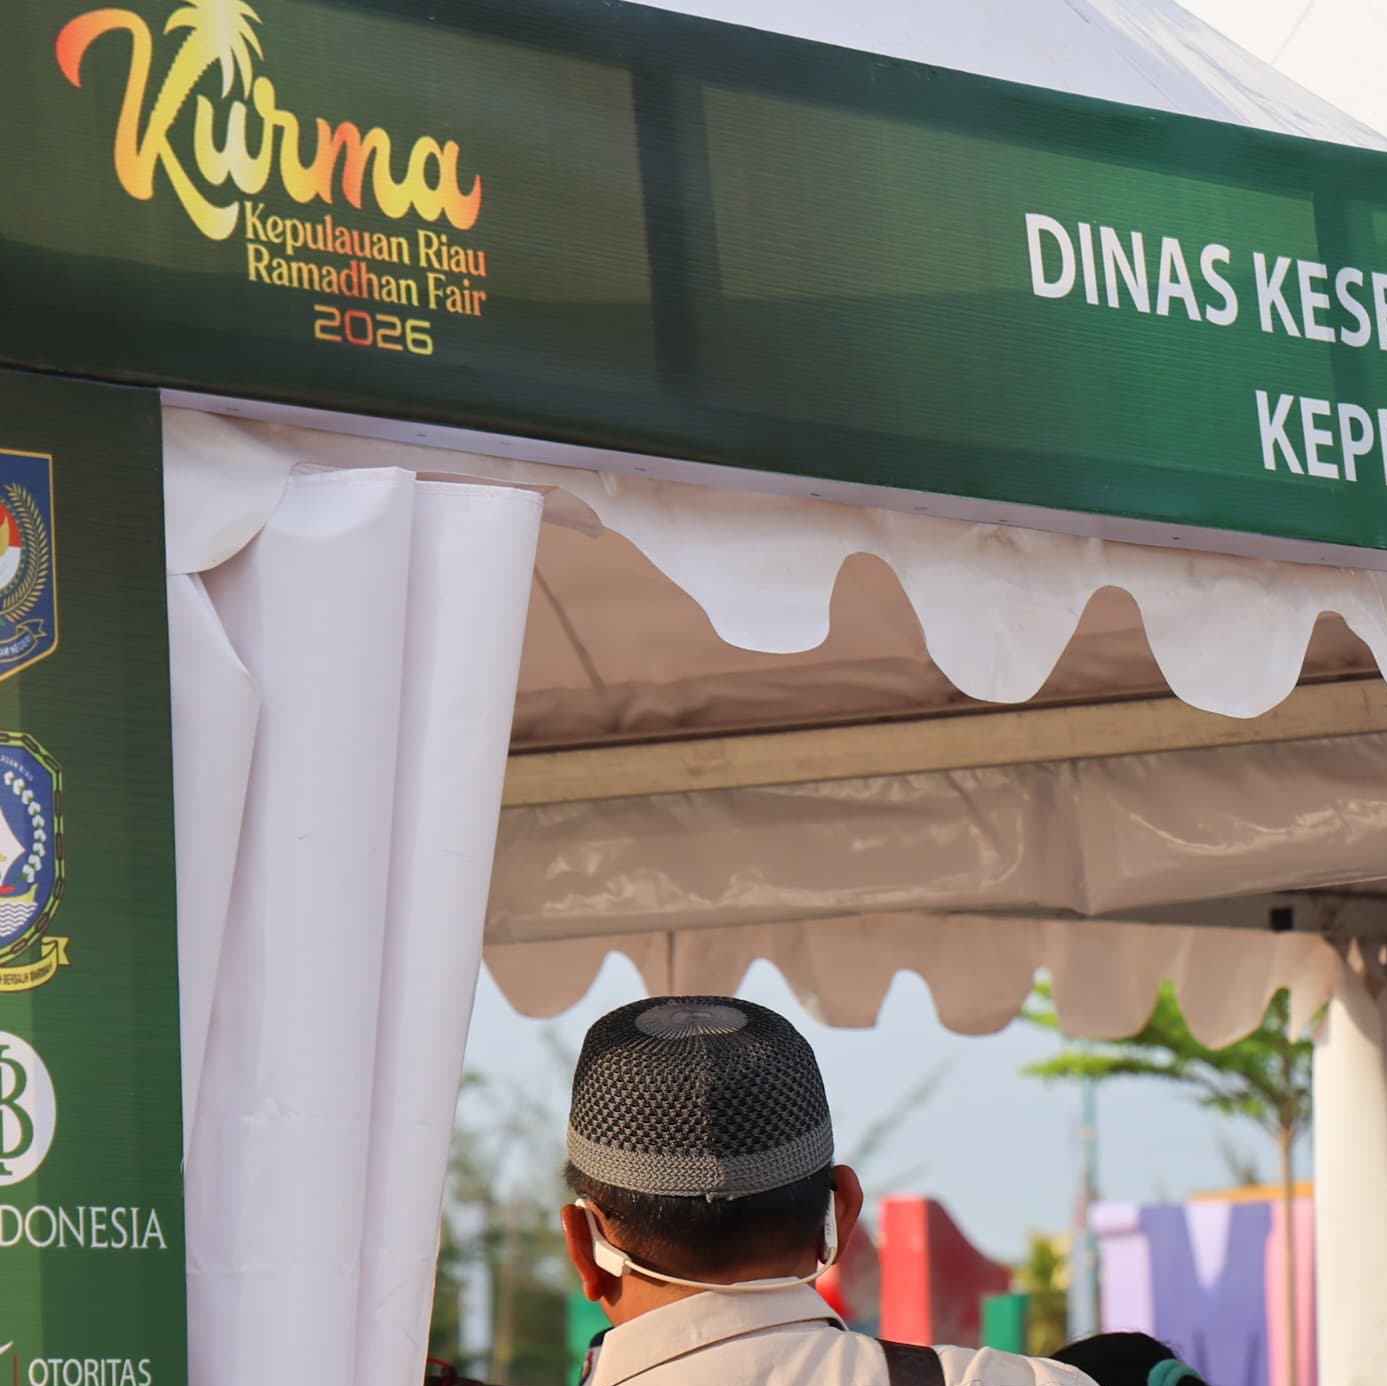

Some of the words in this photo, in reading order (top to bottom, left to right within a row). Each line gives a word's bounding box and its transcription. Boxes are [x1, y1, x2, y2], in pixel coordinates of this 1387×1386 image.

[56, 0, 481, 241] Kurma
[245, 201, 409, 266] Kepulauan
[418, 230, 486, 276] Riau
[1025, 213, 1238, 326] DINAS
[248, 244, 419, 306] Ramadhan
[427, 273, 486, 316] Fair
[314, 305, 433, 355] 2026
